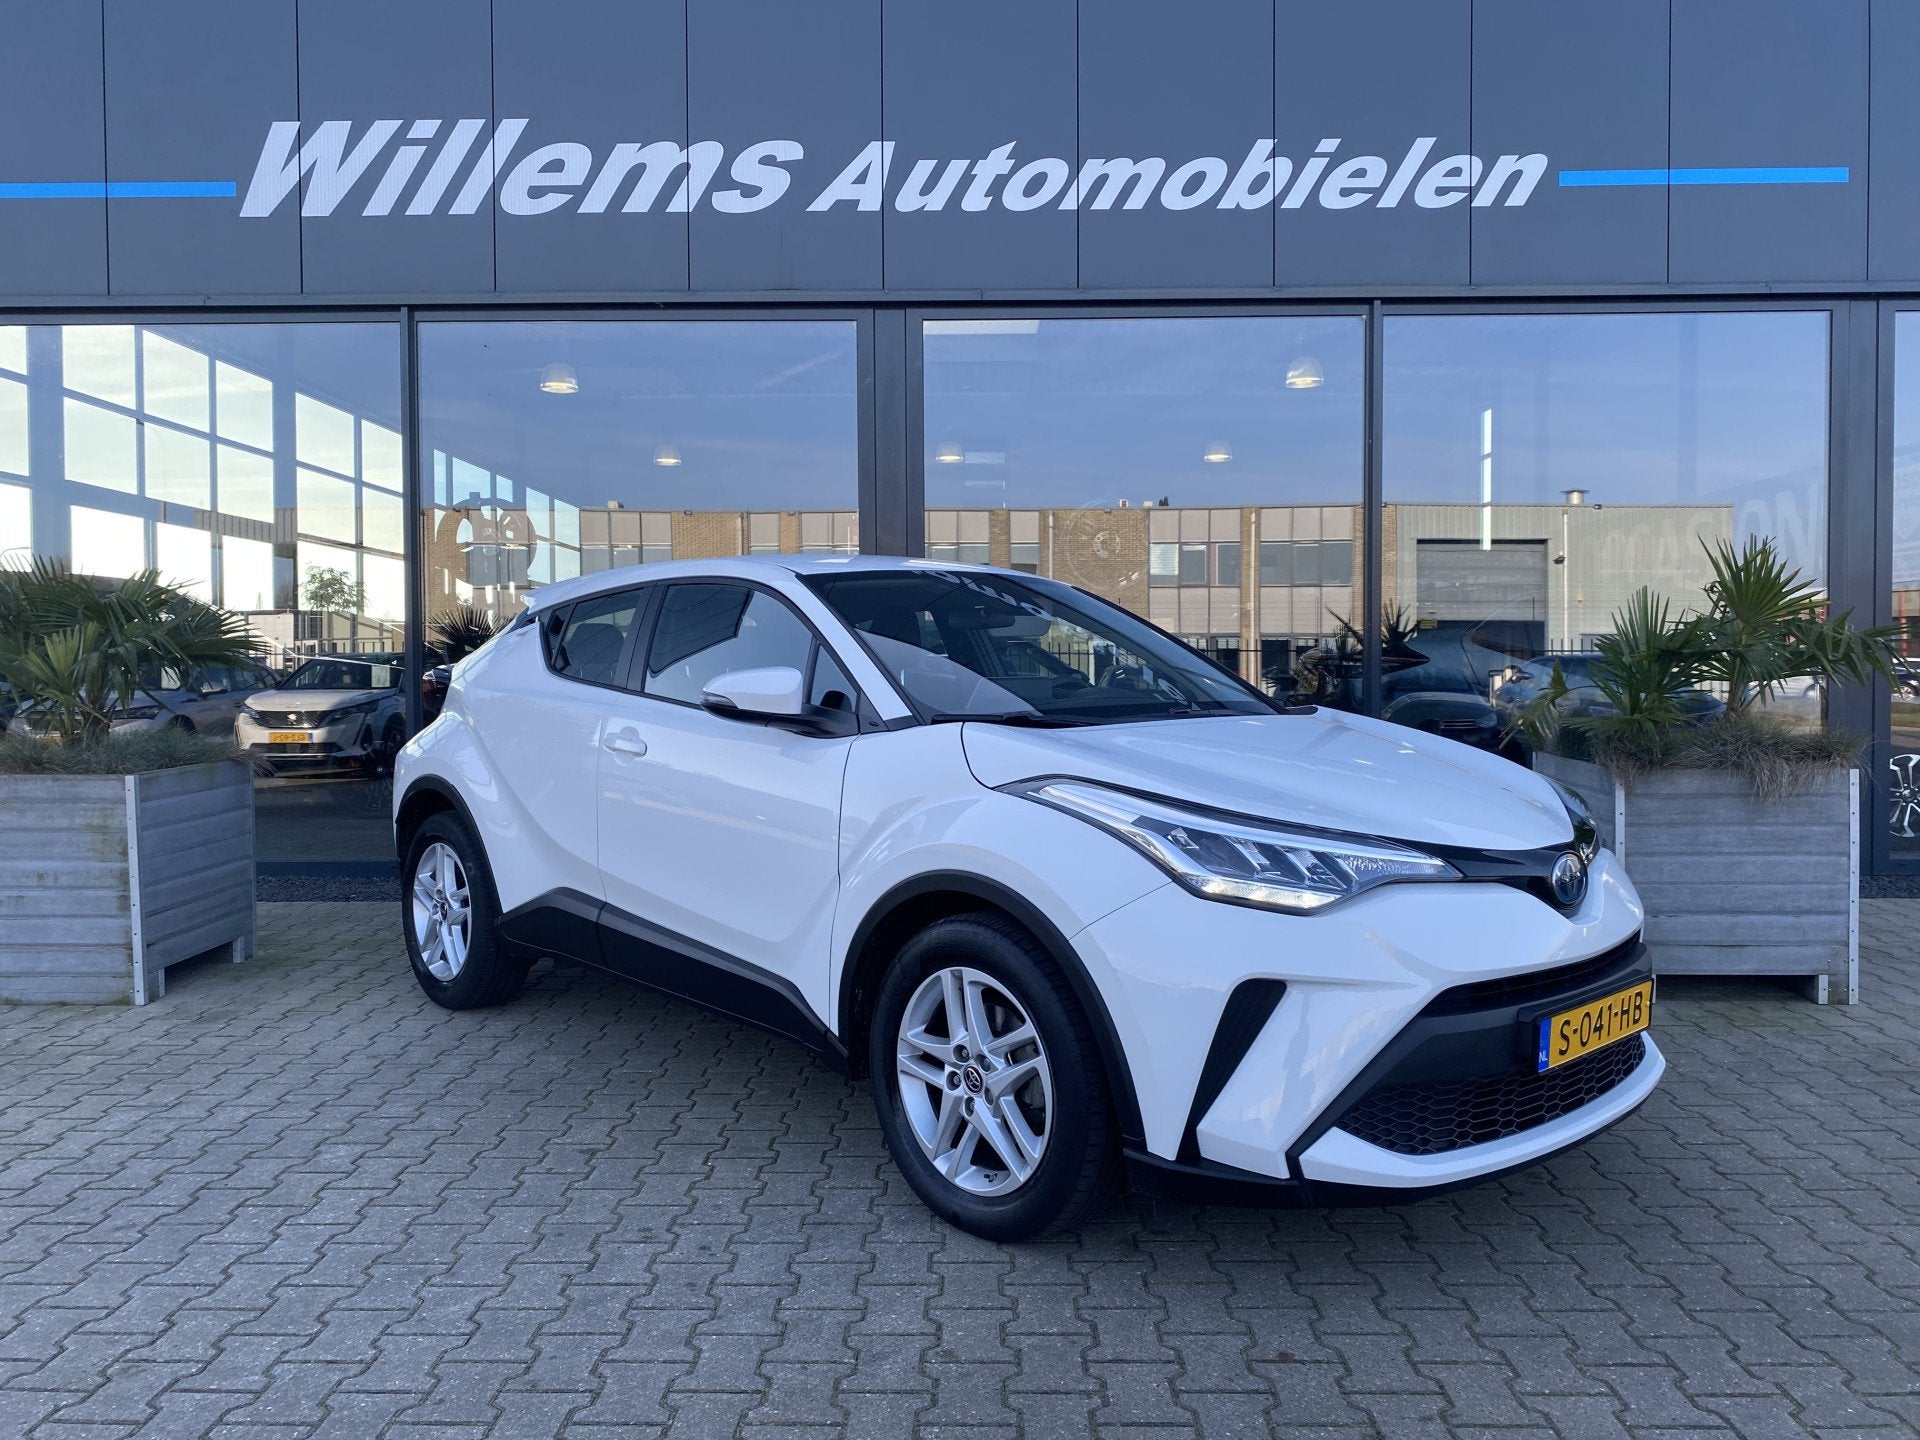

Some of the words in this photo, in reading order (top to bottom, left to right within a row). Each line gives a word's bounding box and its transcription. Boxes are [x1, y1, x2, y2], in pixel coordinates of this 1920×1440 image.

[239, 118, 804, 219] Willems
[805, 136, 1550, 212] Automobielen
[1558, 990, 1644, 1056] S-041-HB
[1538, 1050, 1549, 1063] NL
